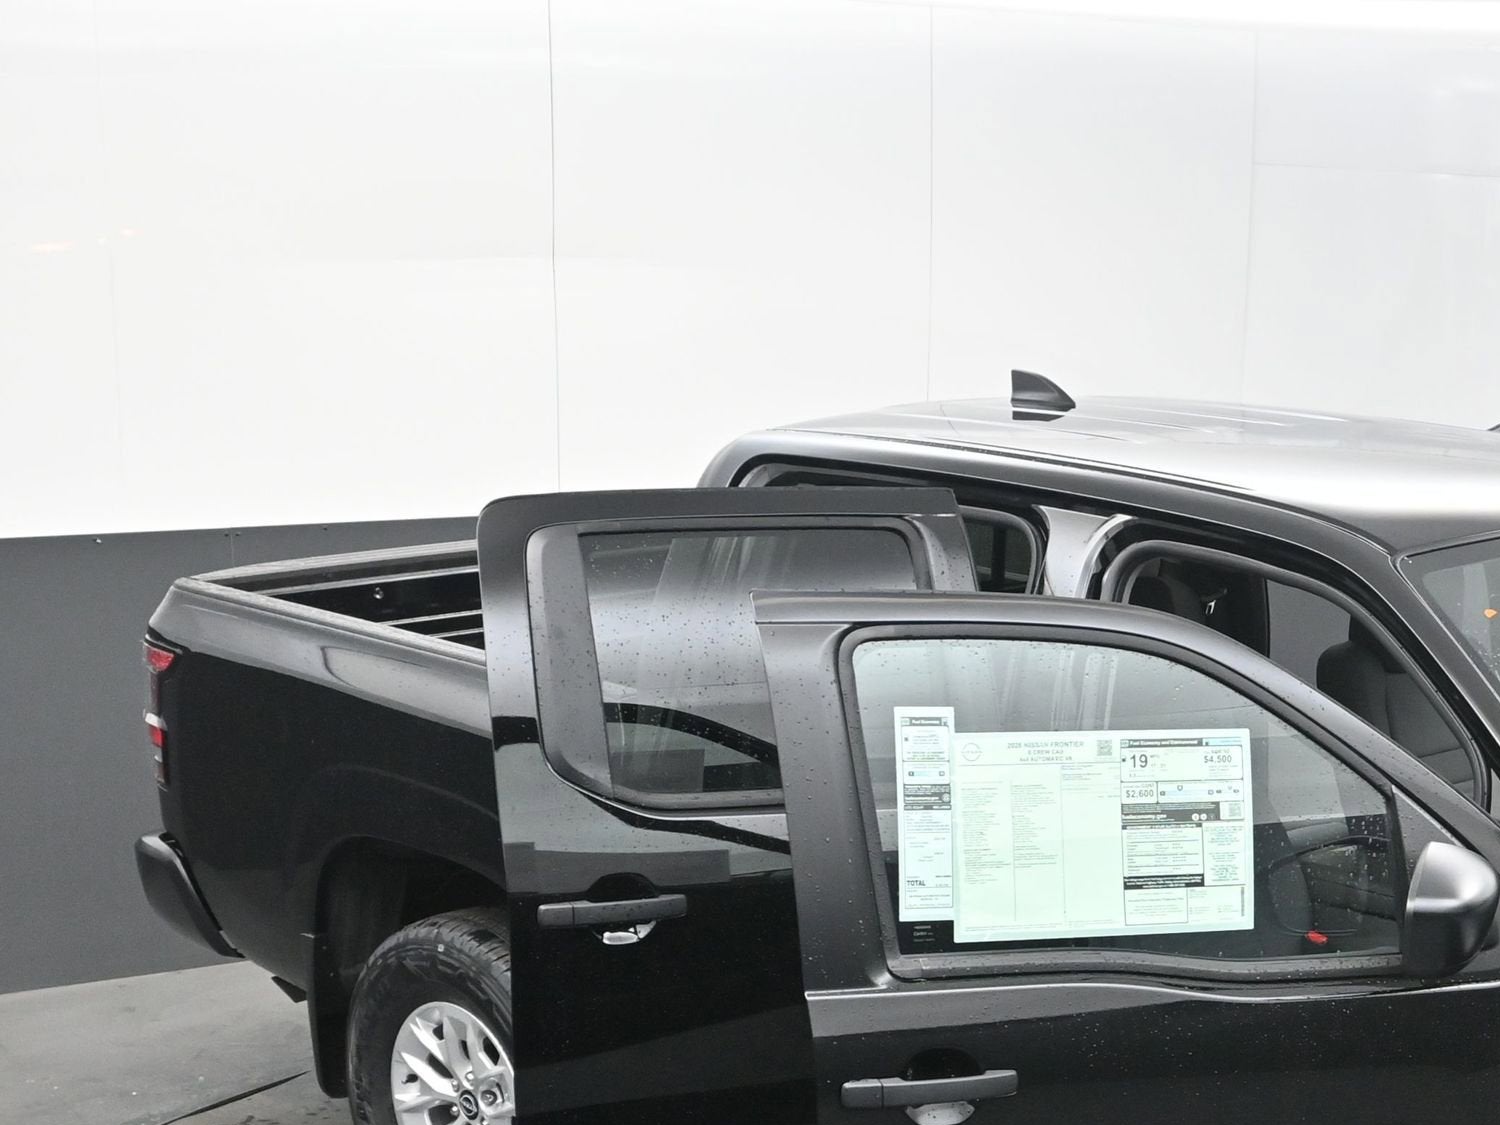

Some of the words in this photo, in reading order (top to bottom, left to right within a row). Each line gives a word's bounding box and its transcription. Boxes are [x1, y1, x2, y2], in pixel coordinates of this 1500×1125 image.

[1129, 754, 1148, 768] 19
[1203, 755, 1232, 764] $4,500
[1125, 789, 1154, 799] $2,600
